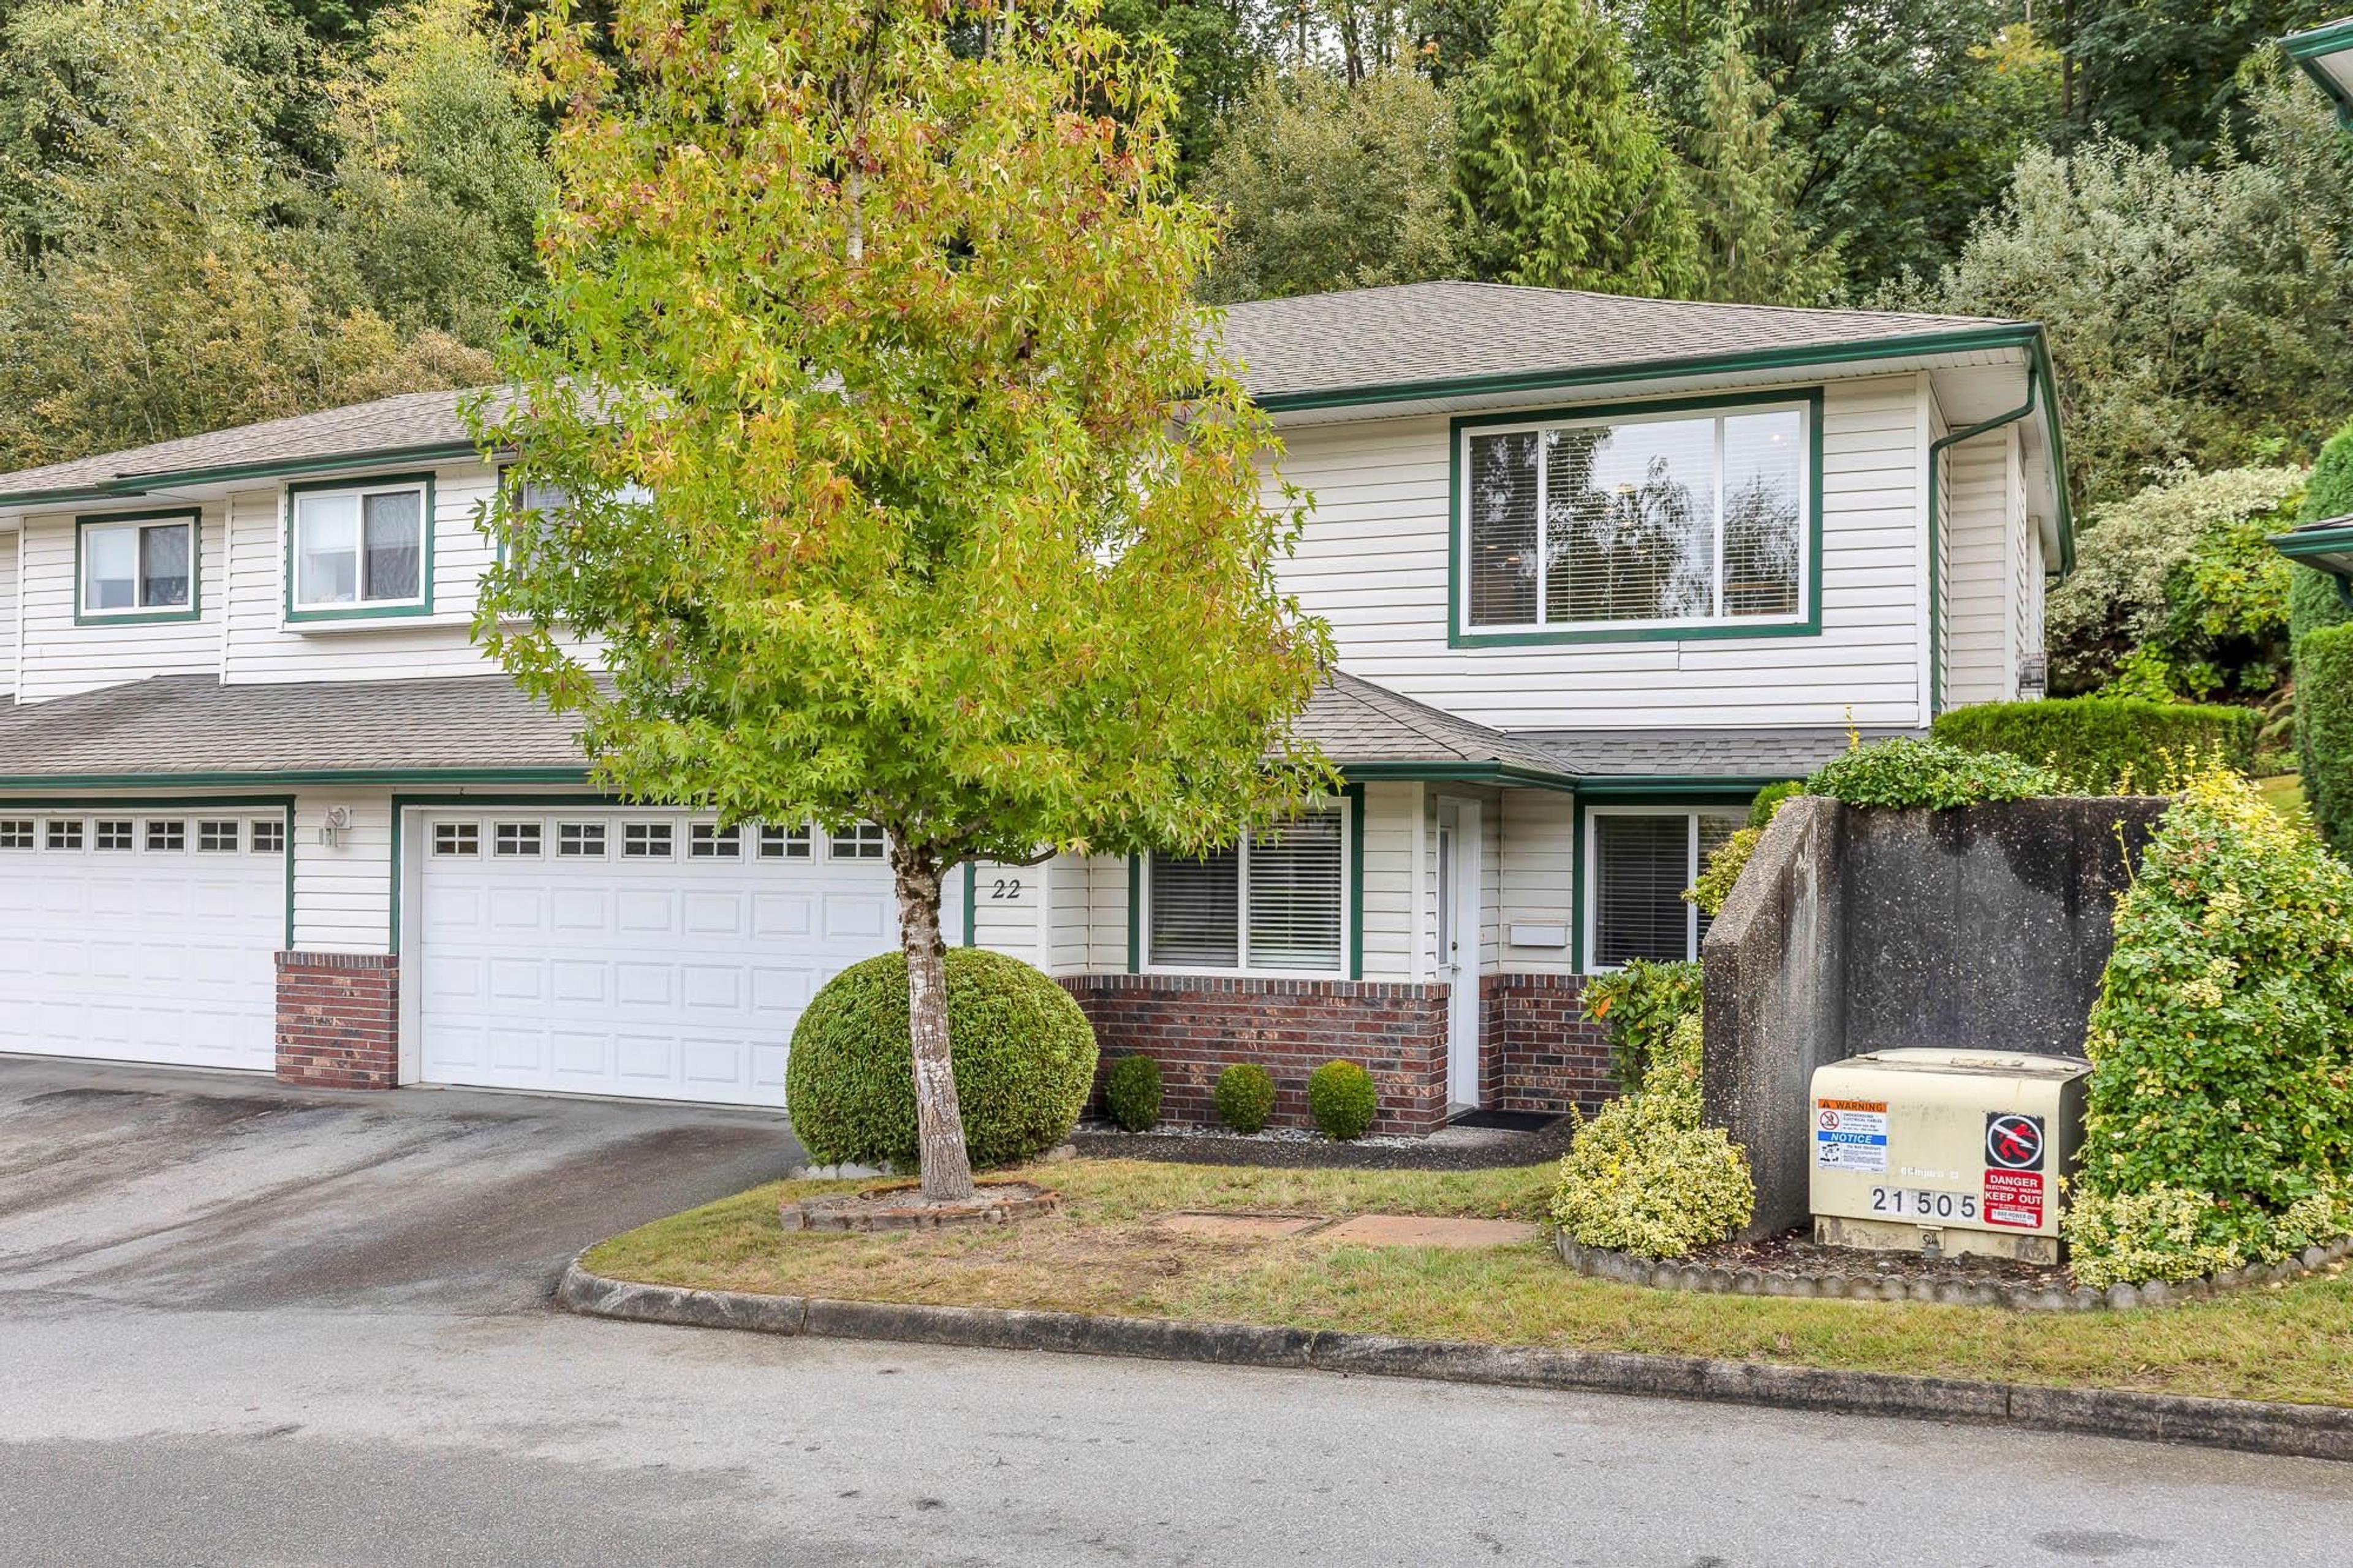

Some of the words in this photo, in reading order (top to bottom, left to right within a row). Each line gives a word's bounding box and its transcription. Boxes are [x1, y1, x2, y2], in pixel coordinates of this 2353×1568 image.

[991, 879, 1020, 899] 22
[1835, 1101, 1883, 1112] WARNING
[1830, 1132, 1873, 1144] NOTICE
[1990, 1175, 2038, 1187] DANGER
[1985, 1191, 2014, 1202] KEEP
[2019, 1194, 2042, 1205] OUT
